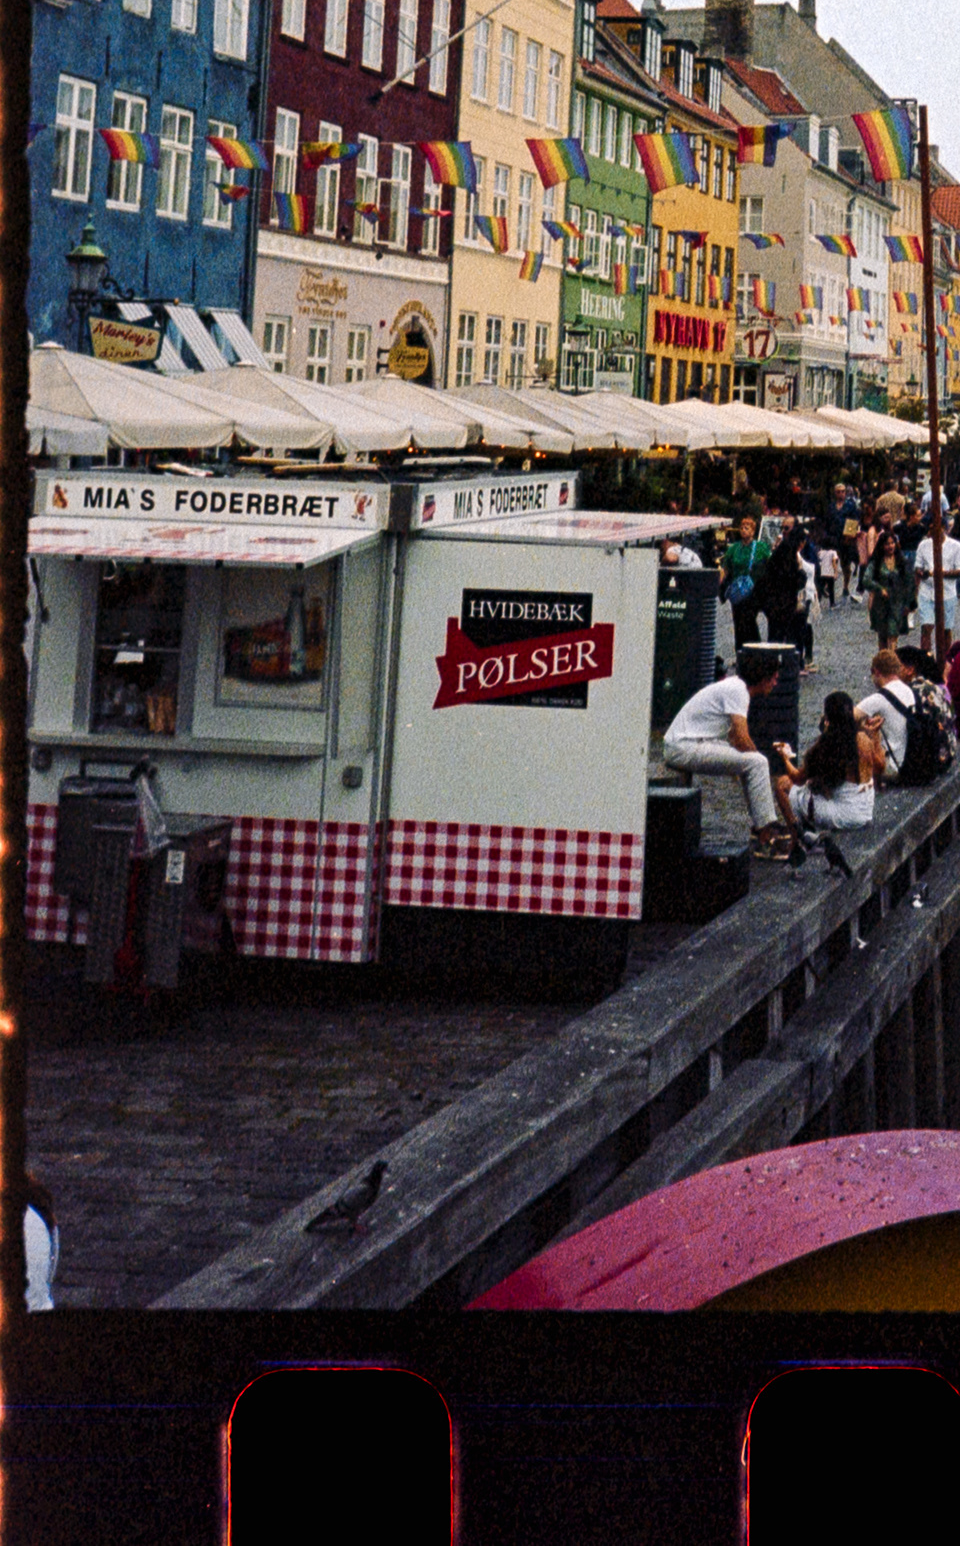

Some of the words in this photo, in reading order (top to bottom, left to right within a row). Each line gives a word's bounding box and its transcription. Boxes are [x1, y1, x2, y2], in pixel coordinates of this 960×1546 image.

[581, 288, 626, 321] HEERING
[93, 321, 156, 347] Marley's
[653, 310, 710, 350] NYHAVN
[713, 321, 726, 353] 17
[744, 329, 771, 359] 17
[175, 489, 339, 519] FODERBRÆT
[490, 483, 548, 514] FODERBRÆT
[469, 600, 585, 623] HVIDEBÆK
[659, 600, 687, 609] Affald
[455, 639, 599, 694] PØLSER
